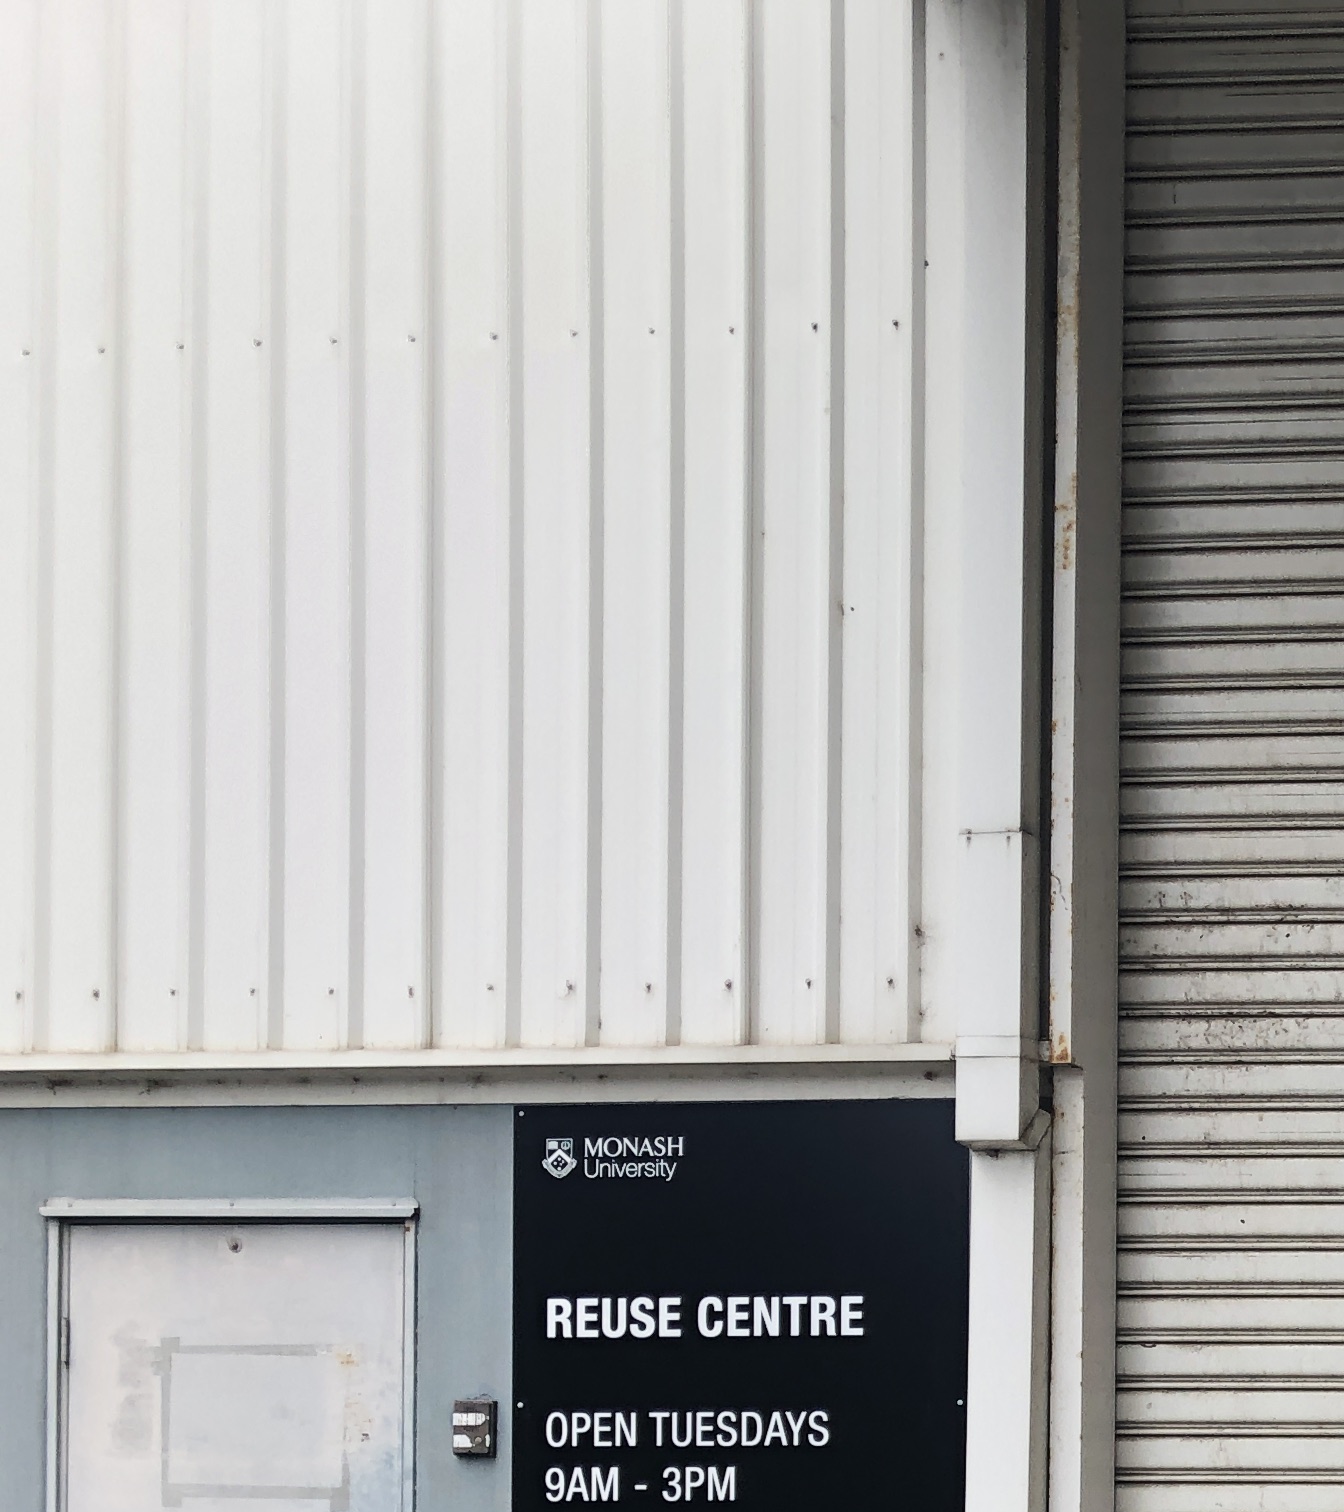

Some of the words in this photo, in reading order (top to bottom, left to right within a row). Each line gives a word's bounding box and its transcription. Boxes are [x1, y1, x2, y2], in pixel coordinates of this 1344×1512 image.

[584, 1136, 684, 1158] MONASH
[583, 1158, 679, 1182] University
[546, 1296, 682, 1339] REUSE
[697, 1295, 865, 1338] CENTRE
[545, 1411, 637, 1448] OPEN
[648, 1410, 830, 1448] TUESDAYS
[544, 1466, 619, 1503] 9AM
[661, 1465, 736, 1502] 3PM
